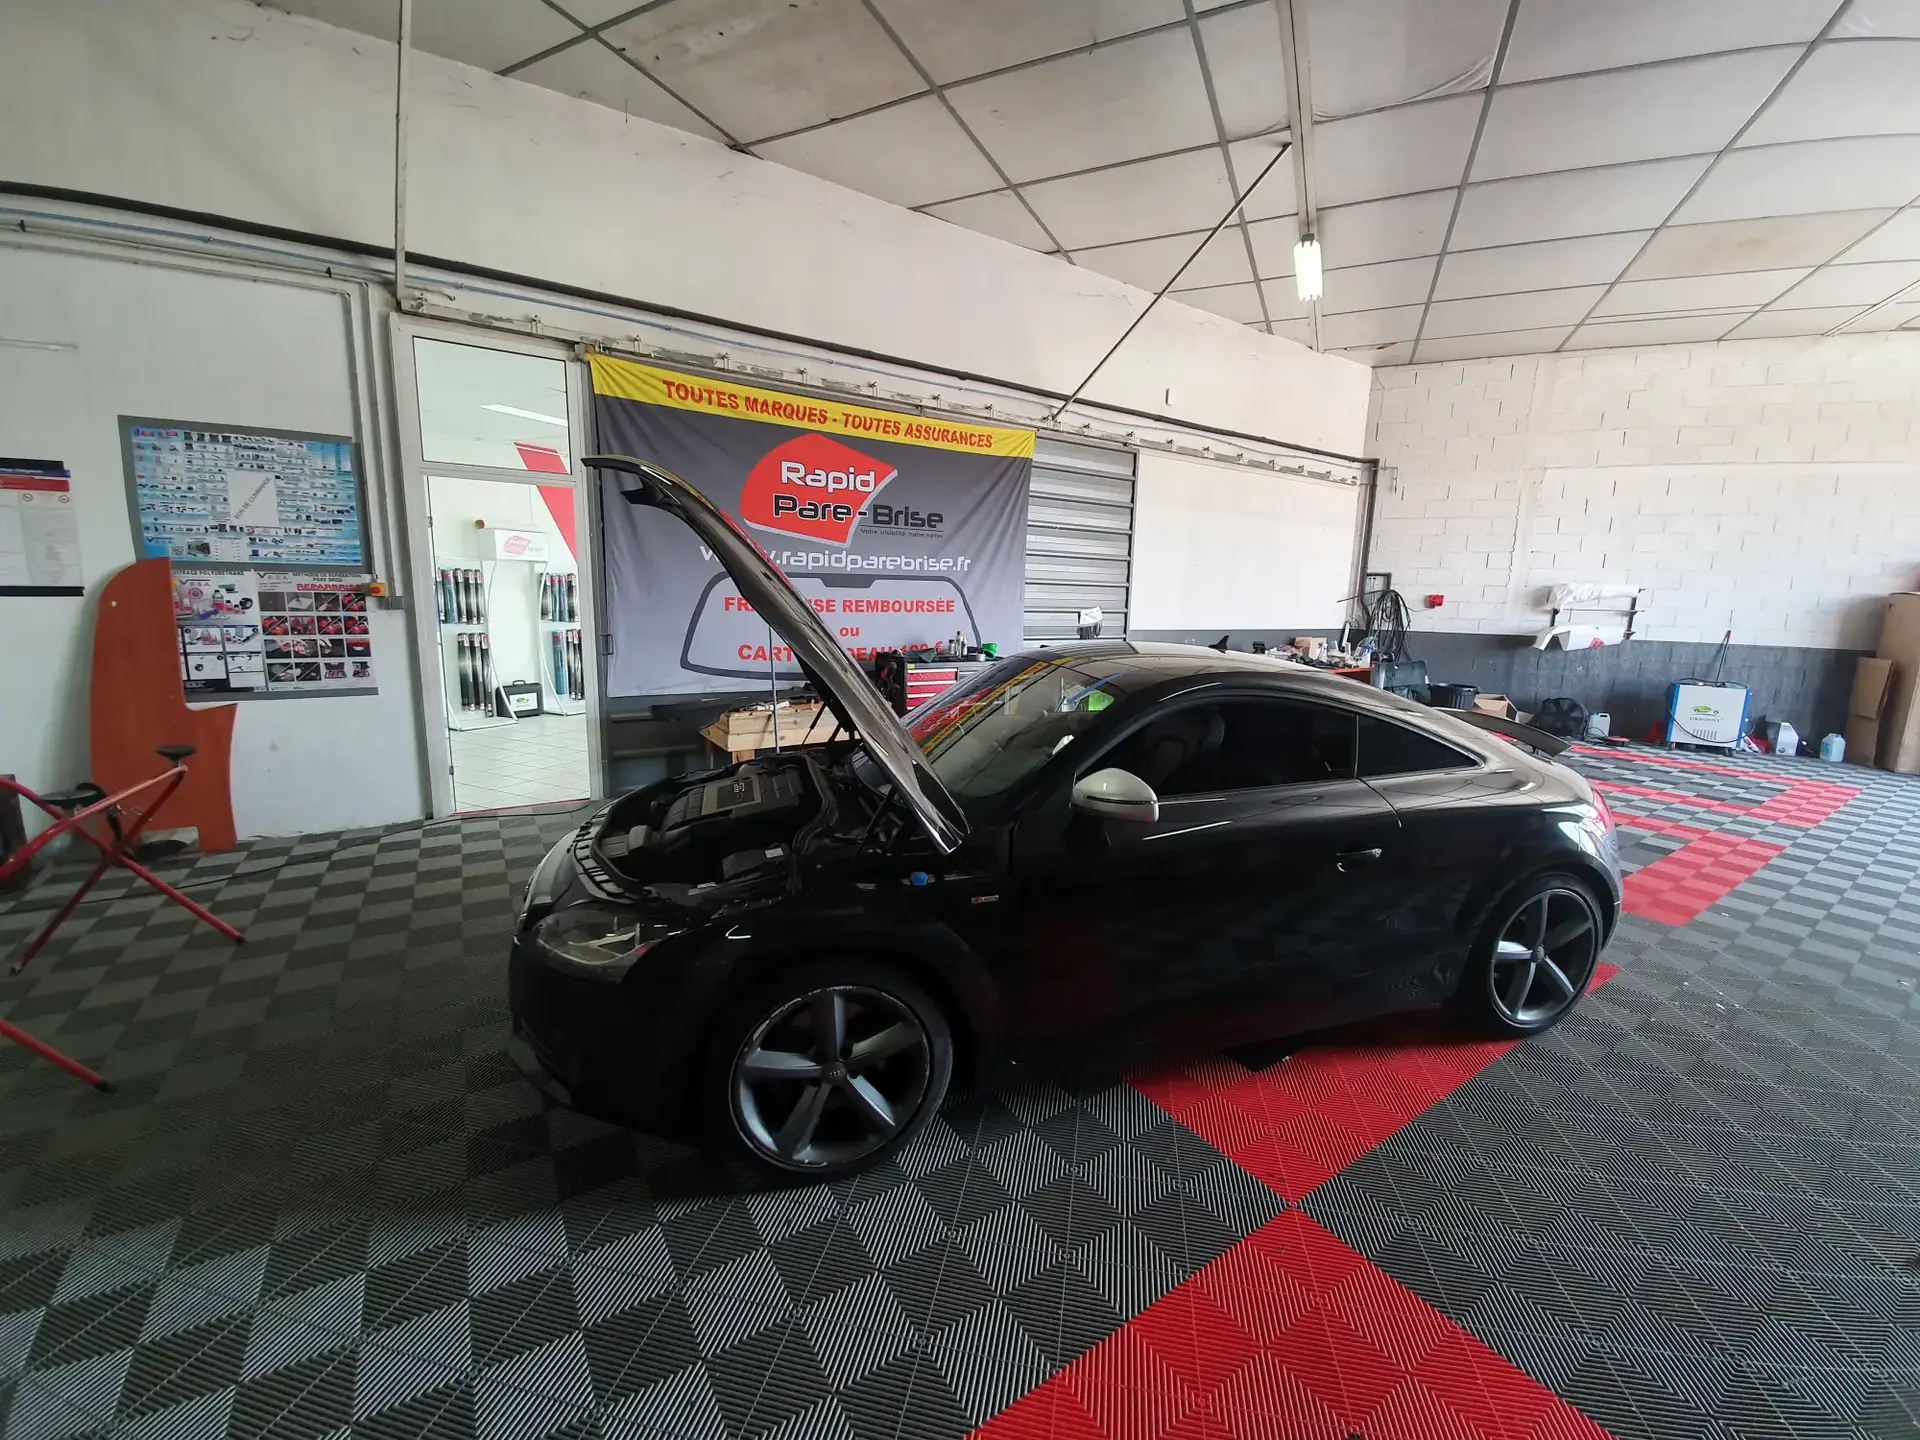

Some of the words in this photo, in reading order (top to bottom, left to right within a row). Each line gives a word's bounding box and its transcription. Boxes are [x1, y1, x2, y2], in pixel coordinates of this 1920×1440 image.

[662, 379, 740, 410] TOUTES
[744, 395, 829, 425] MARQUES
[841, 412, 901, 436] TOUTES
[904, 422, 993, 449] ASSURANCES
[780, 460, 876, 493] Rapid
[842, 597, 955, 613] REMBOURSÉE
[839, 626, 860, 637] ou
[737, 643, 794, 662] CART
